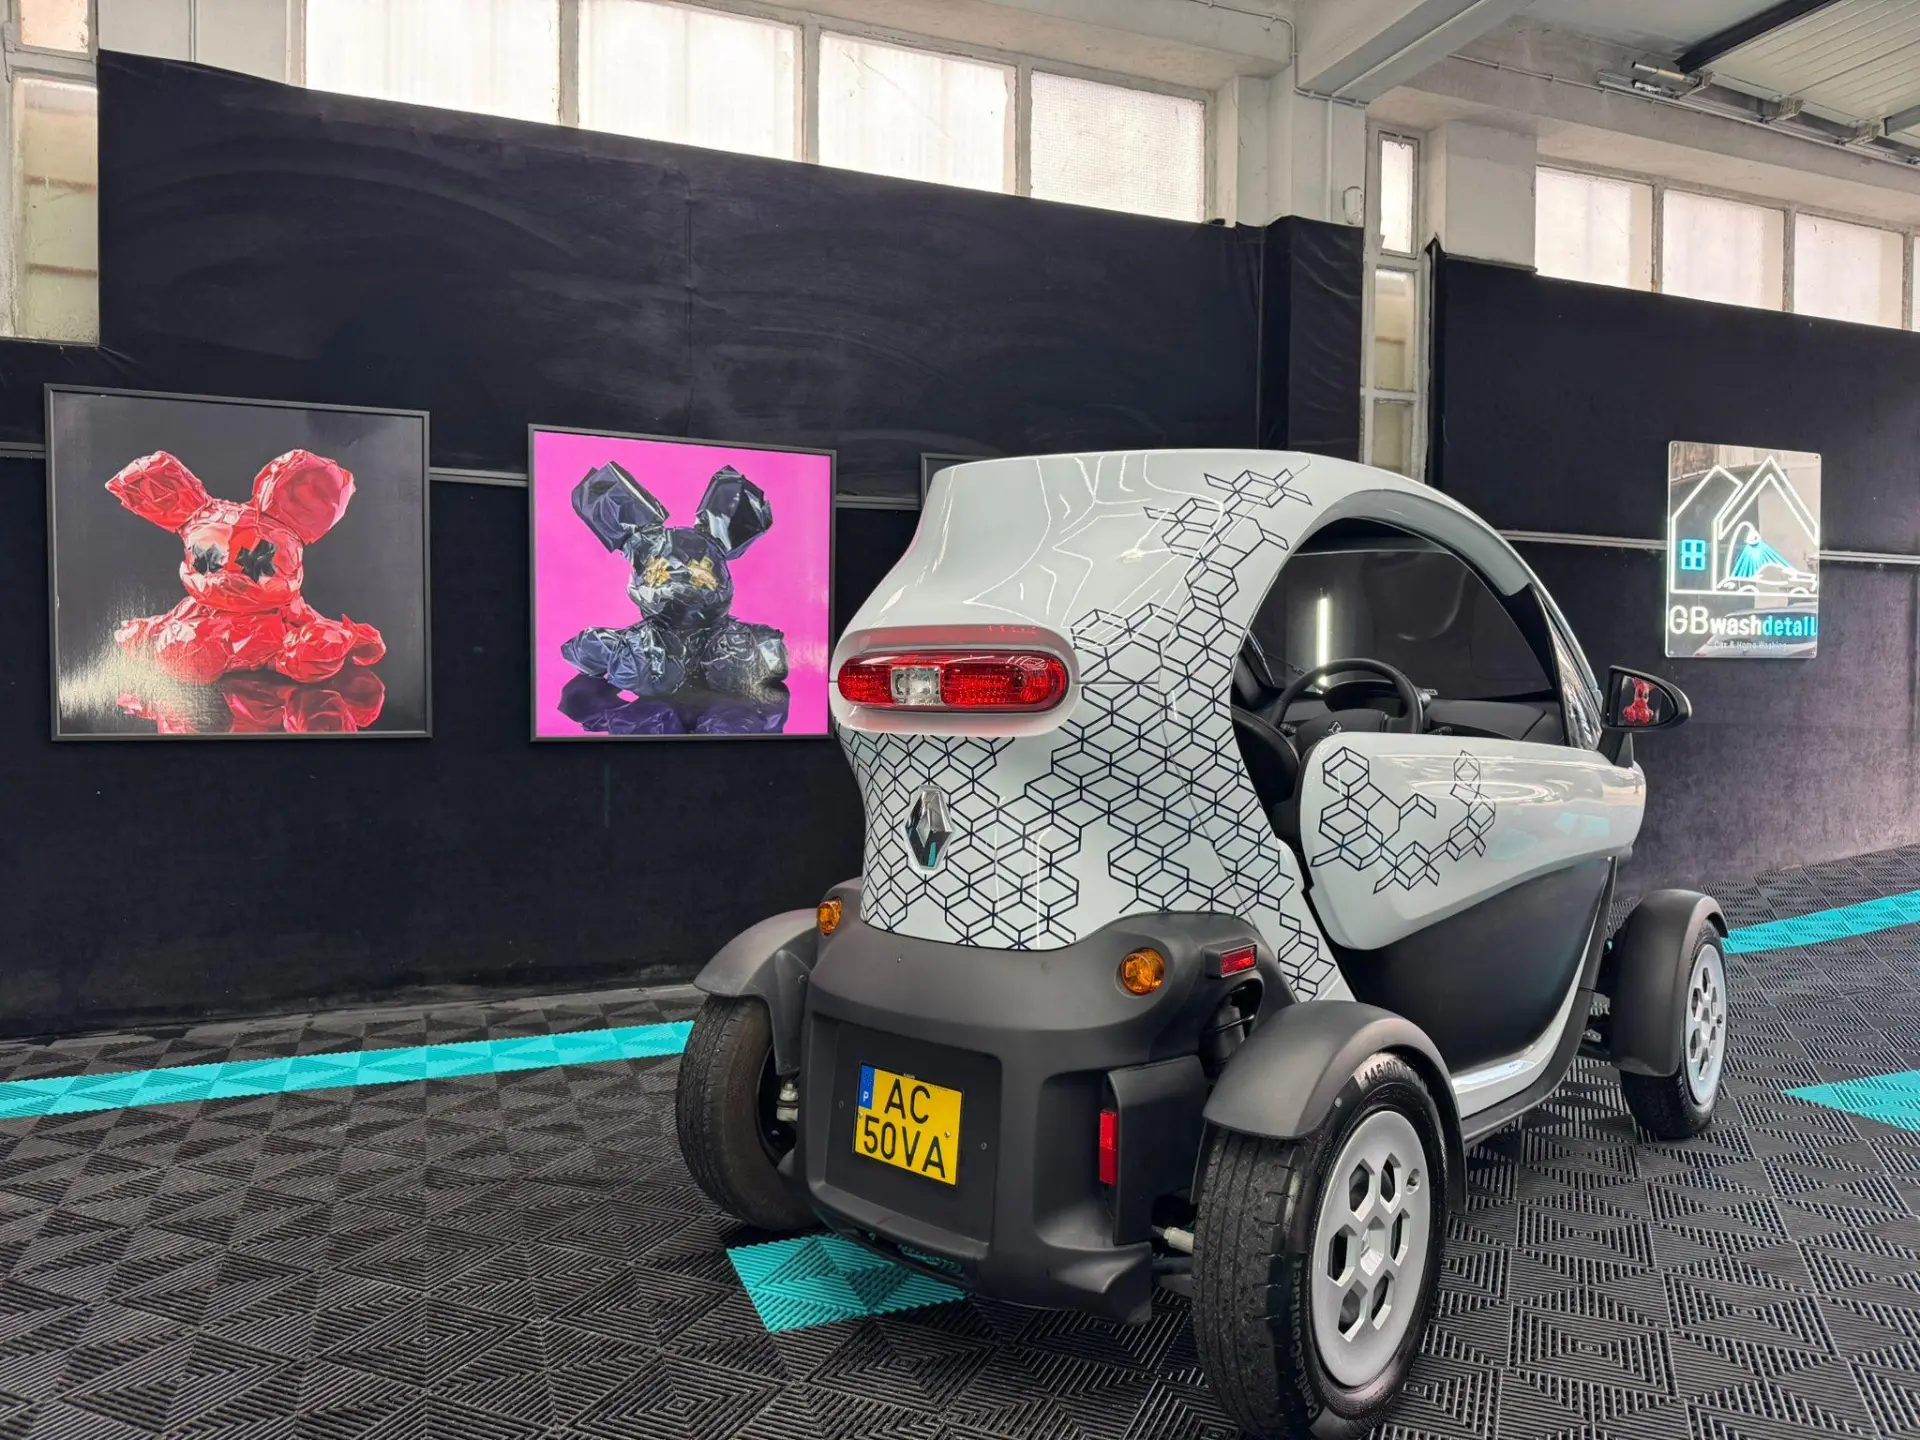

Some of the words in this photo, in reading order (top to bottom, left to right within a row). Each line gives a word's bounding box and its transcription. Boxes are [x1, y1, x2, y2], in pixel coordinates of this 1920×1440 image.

[862, 1091, 869, 1102] P
[884, 1078, 931, 1124] AC
[863, 1114, 946, 1179] 50VA
